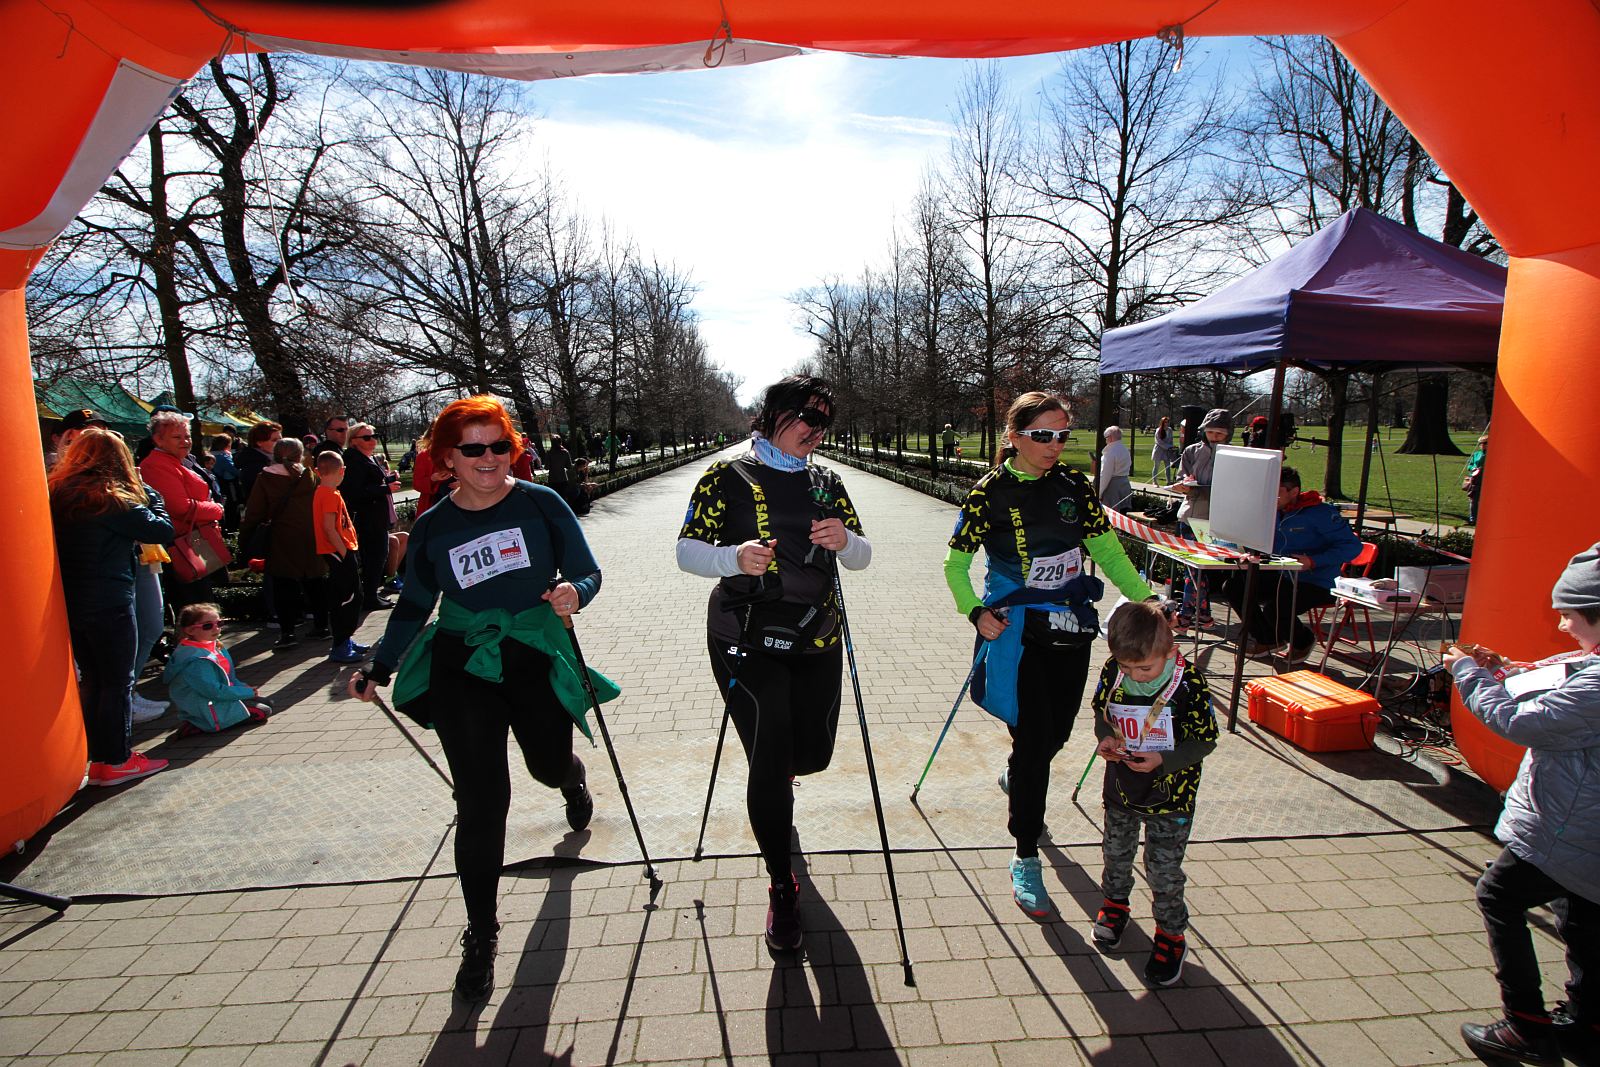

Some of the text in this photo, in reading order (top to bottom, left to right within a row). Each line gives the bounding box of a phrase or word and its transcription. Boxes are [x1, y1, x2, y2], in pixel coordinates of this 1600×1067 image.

[1009, 507, 1022, 526] JKS
[459, 546, 495, 576] 218
[1032, 563, 1065, 582] 229
